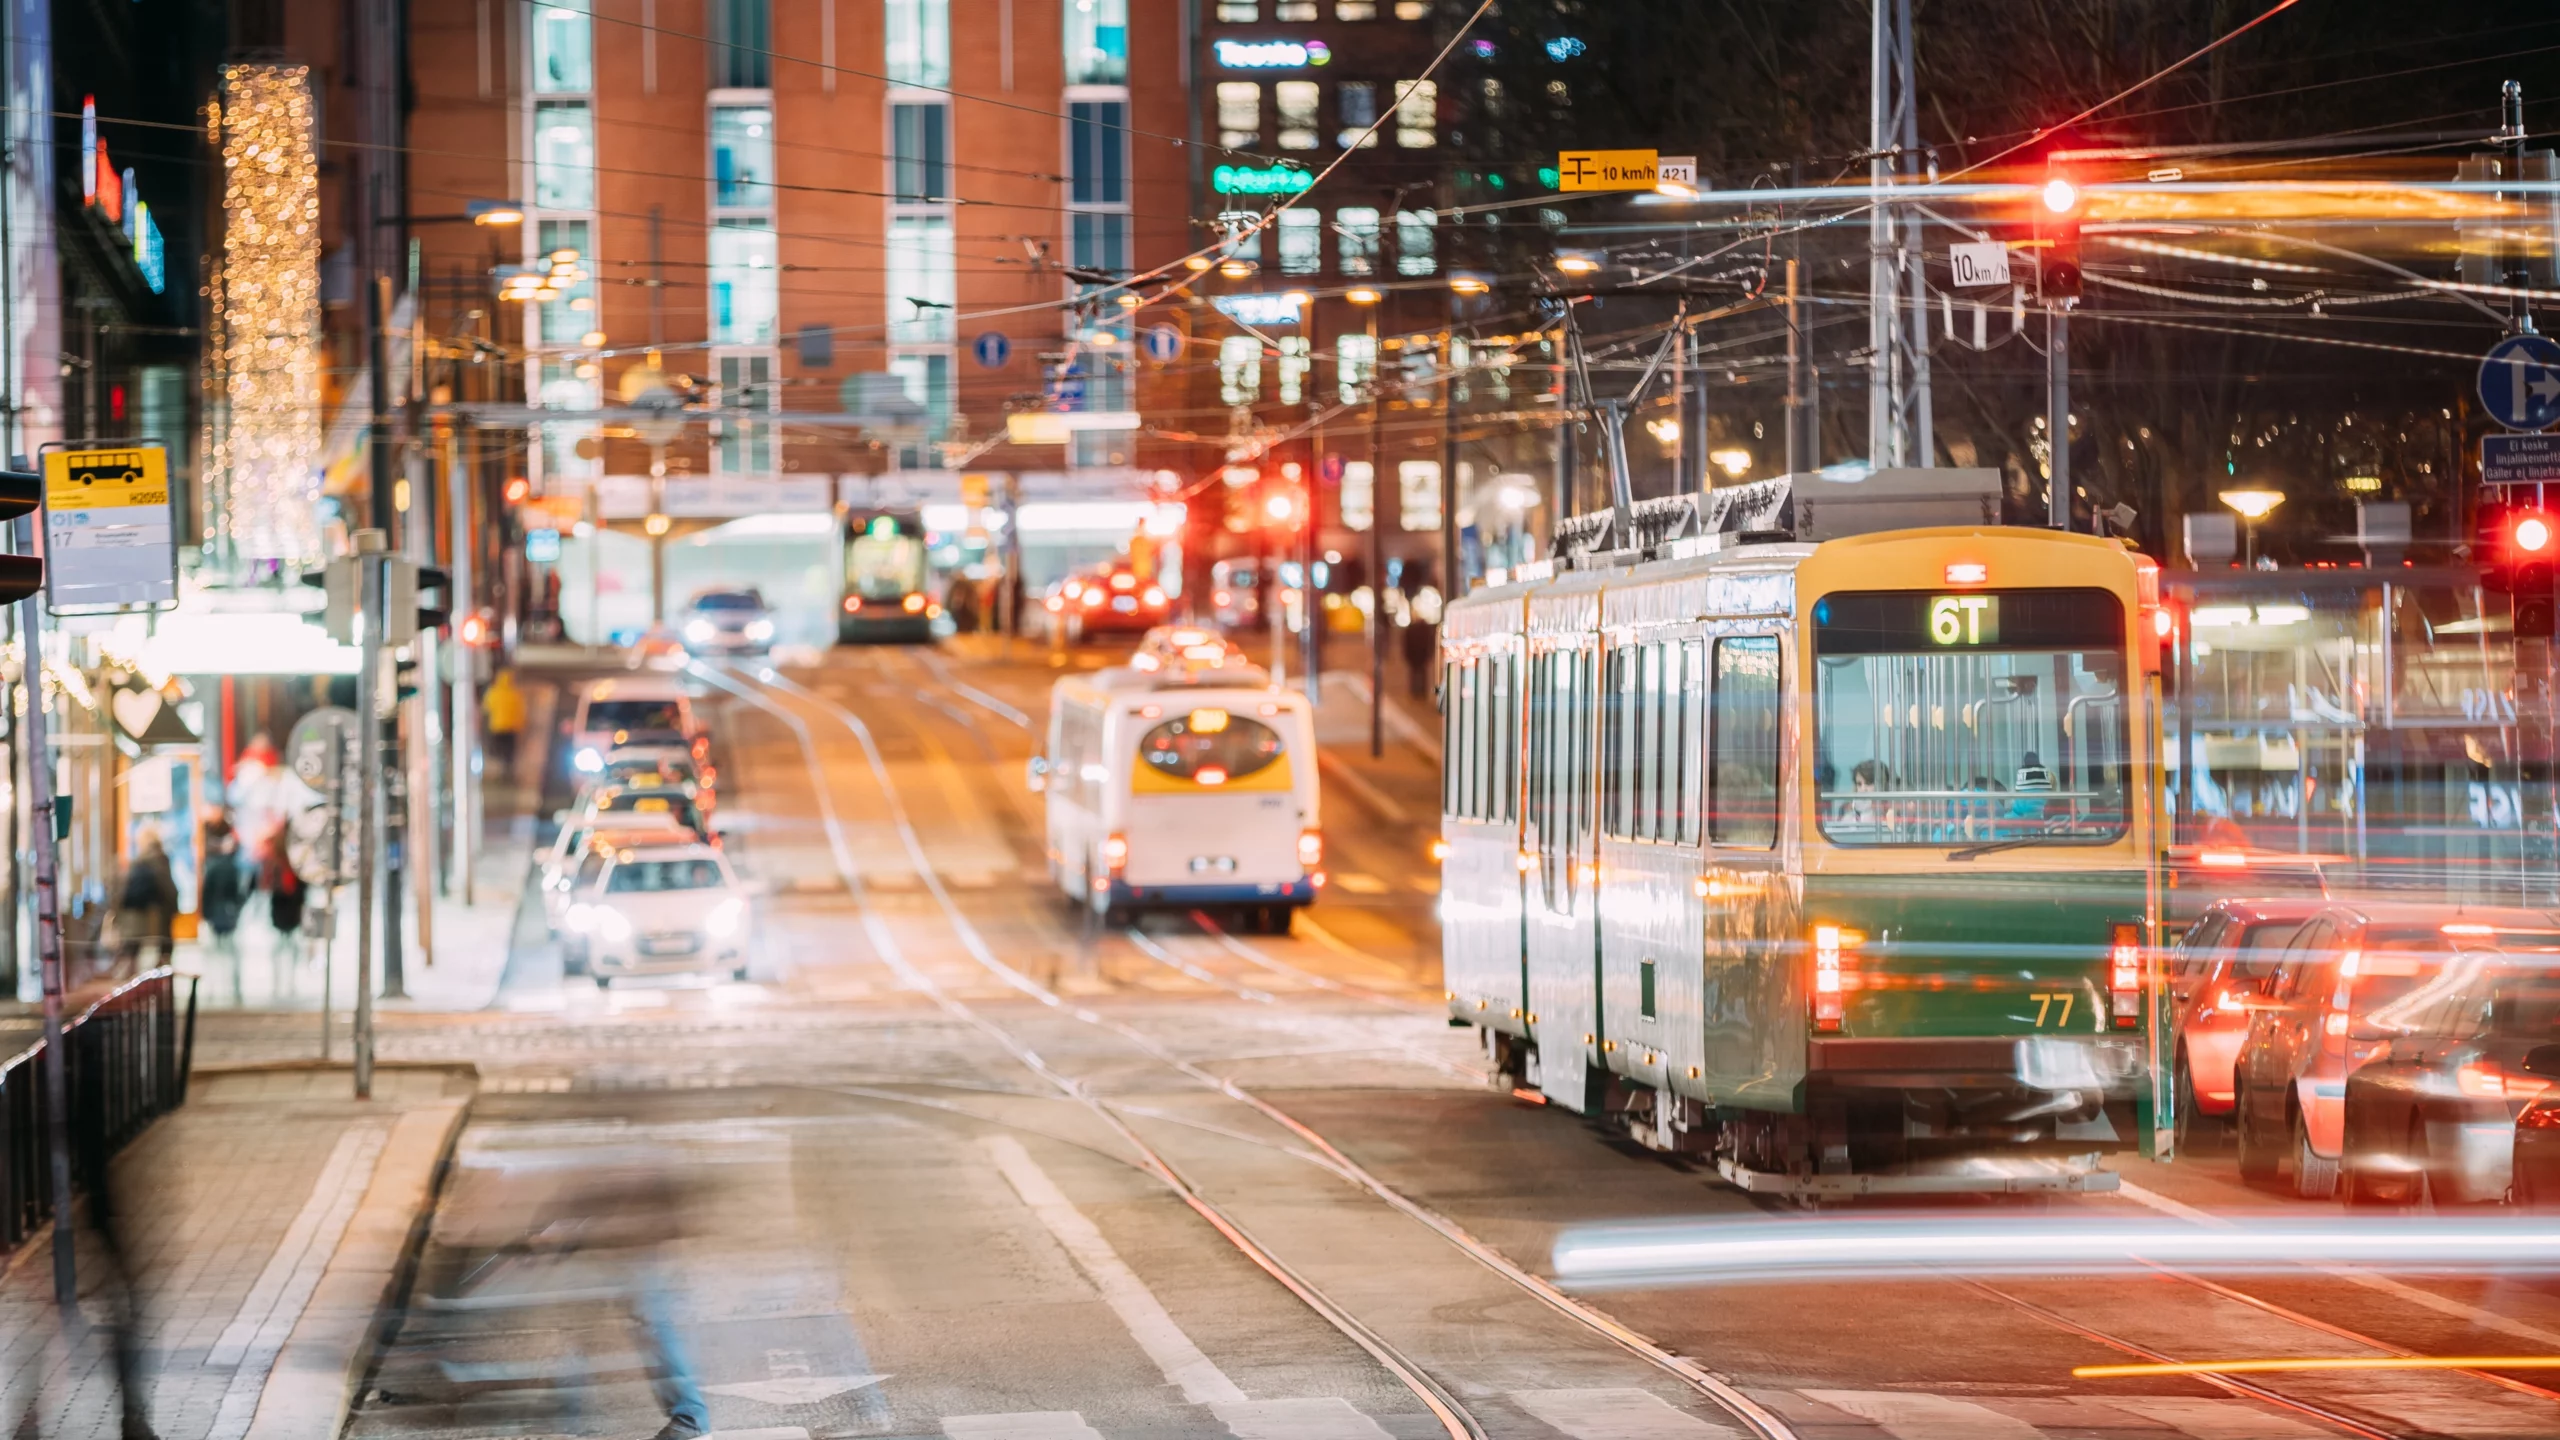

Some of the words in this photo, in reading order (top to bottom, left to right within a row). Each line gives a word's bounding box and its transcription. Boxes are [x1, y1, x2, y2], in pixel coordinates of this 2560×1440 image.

[1602, 167, 1618, 181] 10
[1622, 165, 1655, 181] km/h
[1662, 168, 1688, 181] 421
[52, 531, 74, 547] 17
[1931, 597, 1988, 645] 6T
[2029, 993, 2074, 1028] 77
